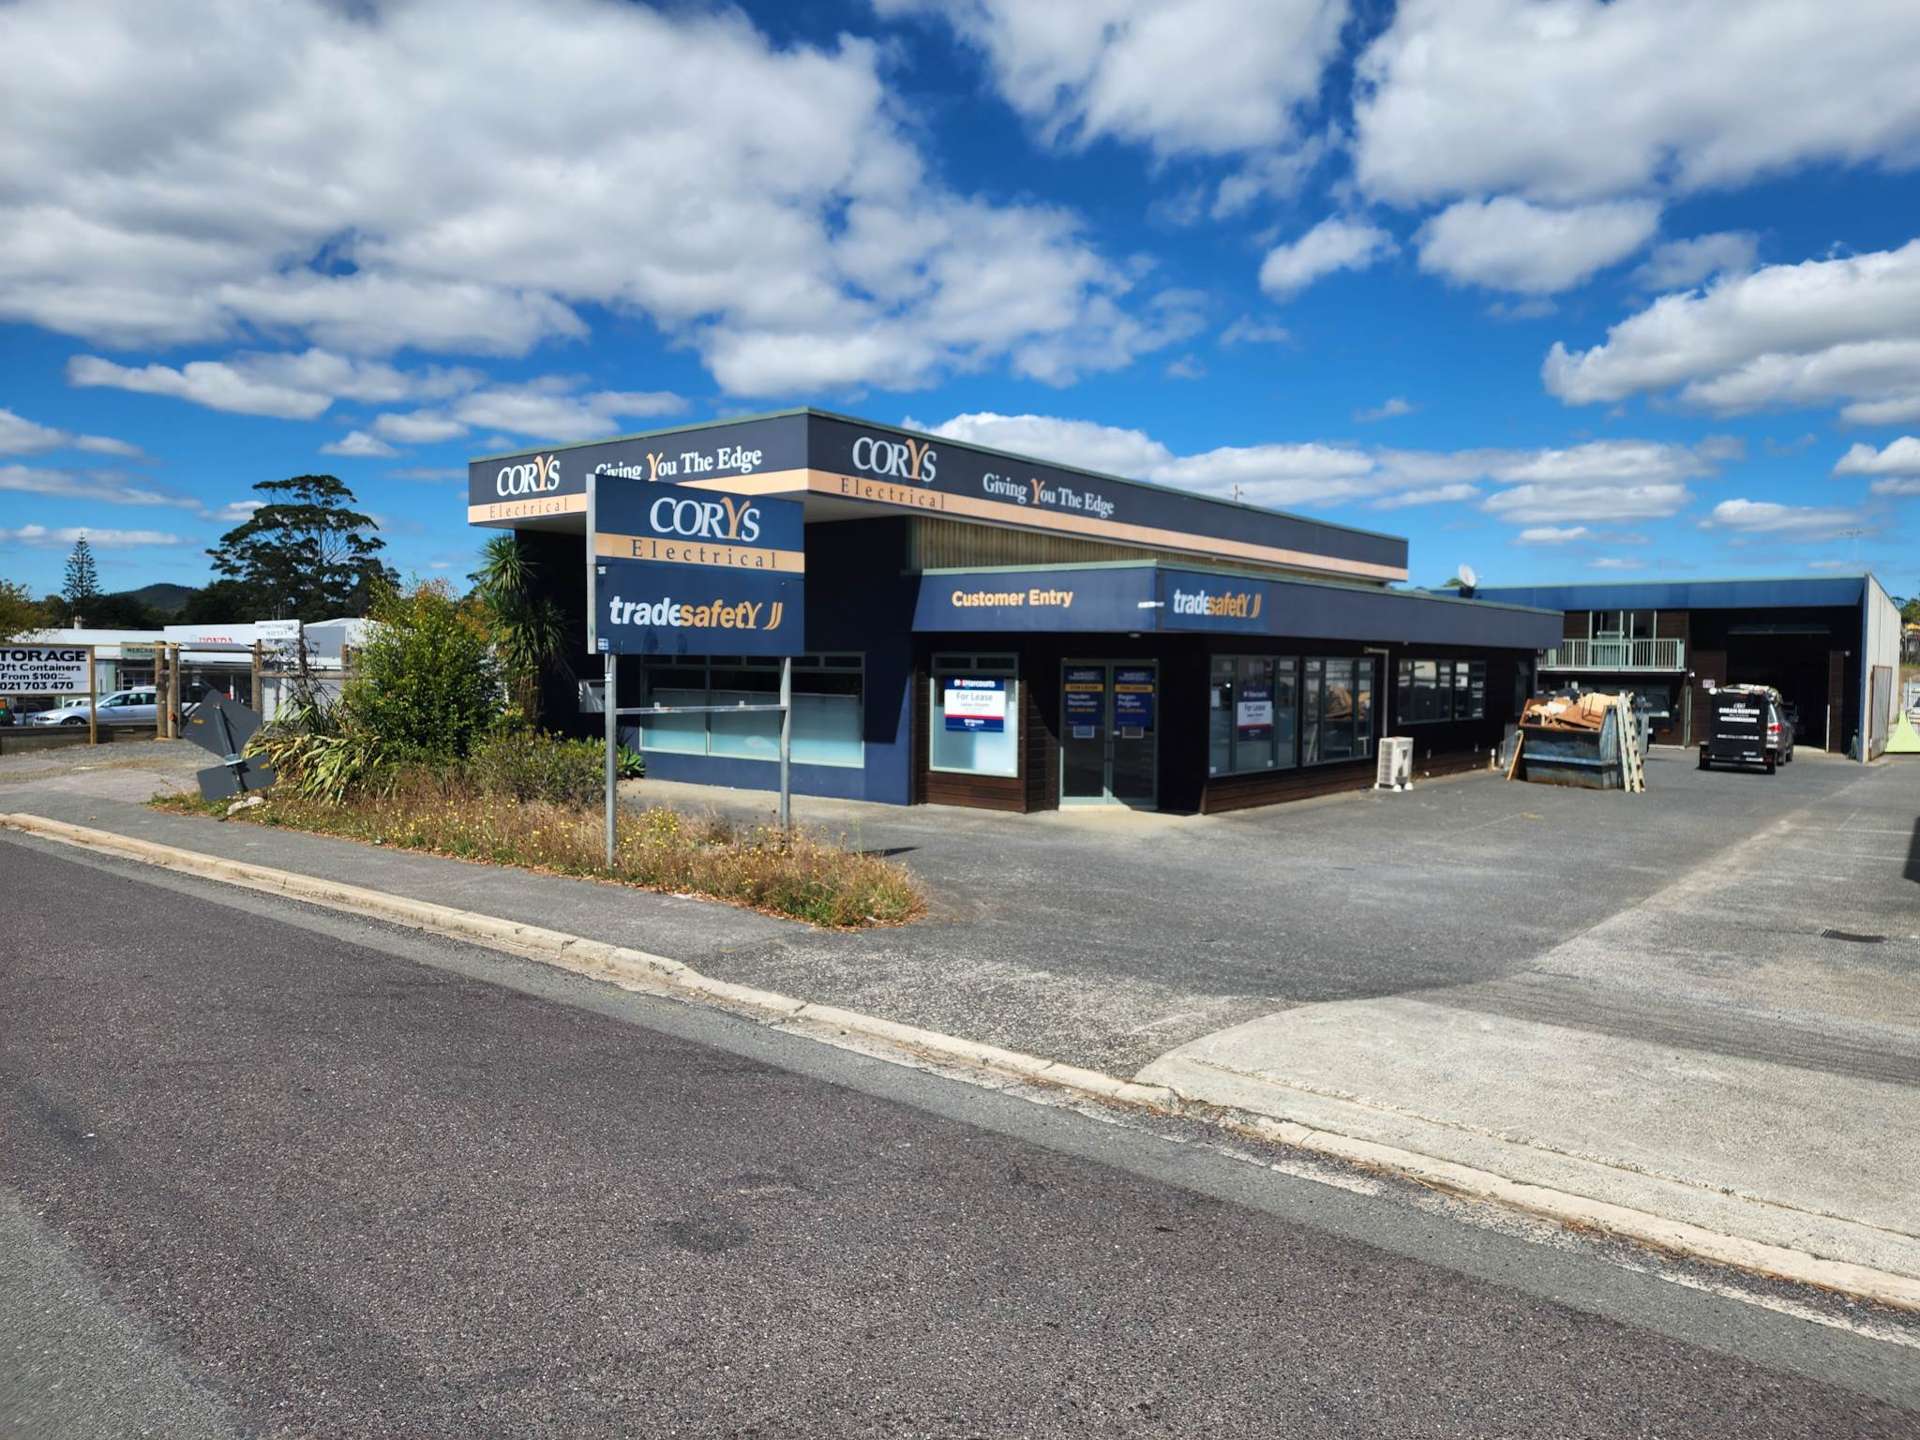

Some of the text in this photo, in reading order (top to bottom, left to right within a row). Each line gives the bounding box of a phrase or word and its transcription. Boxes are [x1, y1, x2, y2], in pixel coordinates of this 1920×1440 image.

[646, 452, 677, 482] You
[680, 452, 714, 474] The
[717, 446, 762, 474] Edge
[852, 437, 937, 482] CORYS
[496, 454, 560, 496] CORYS
[490, 496, 568, 519] Electrical
[840, 478, 945, 510] Electrical
[982, 473, 1115, 519] Giving You The Edge
[650, 496, 760, 542] CORYS
[631, 539, 776, 568] Electrical
[952, 589, 1074, 608] Customer Entry
[0, 650, 88, 662] TORAGE
[0, 664, 82, 672] 0ft Containers
[0, 682, 74, 690] 021 703 470
[32, 672, 58, 680] $100
